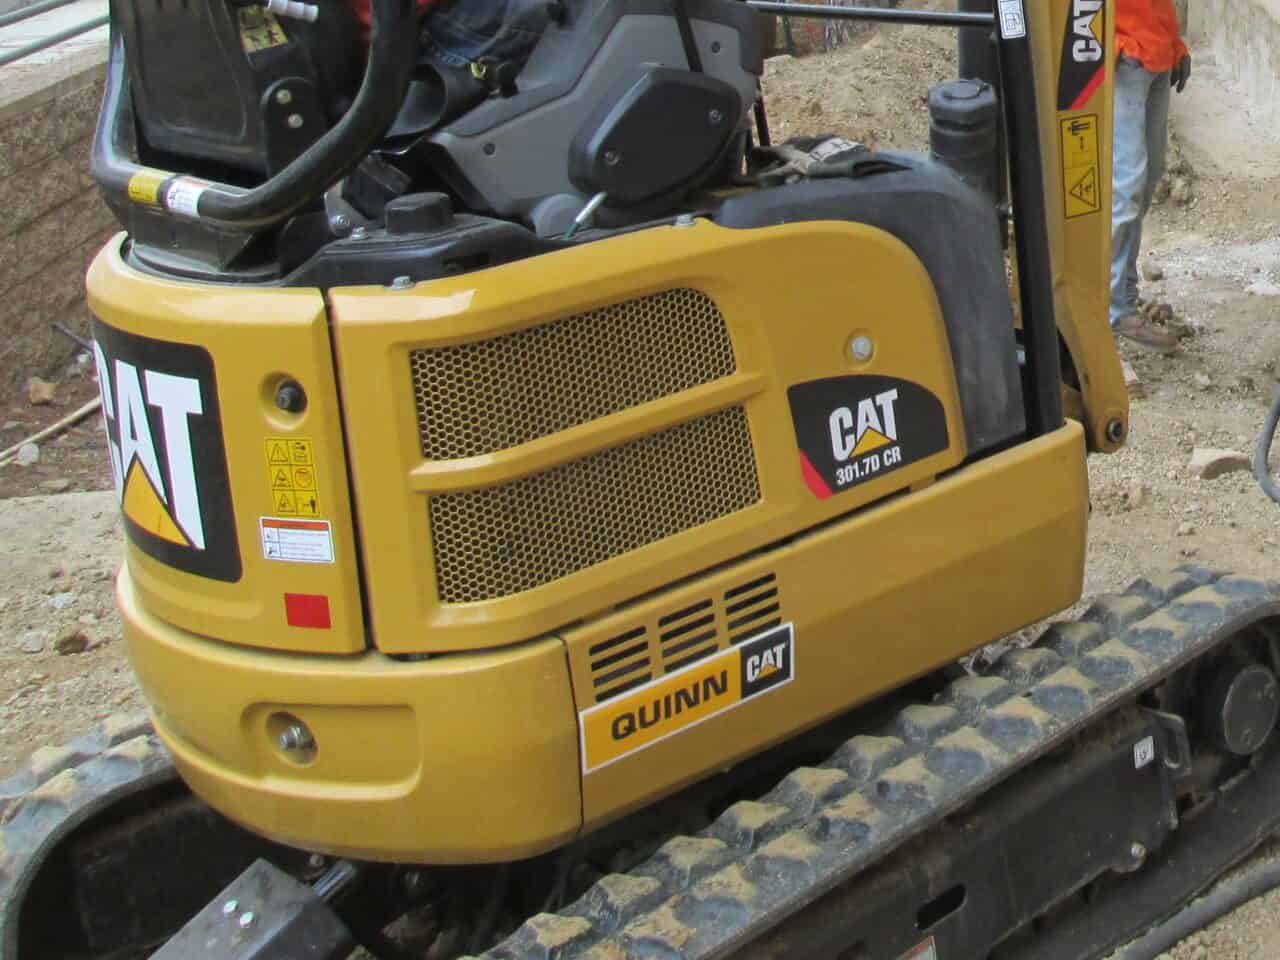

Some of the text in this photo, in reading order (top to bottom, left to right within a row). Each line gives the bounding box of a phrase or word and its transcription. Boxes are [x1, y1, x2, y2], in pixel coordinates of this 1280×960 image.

[829, 389, 898, 461] CAT
[836, 446, 902, 485] 301.7D CR
[611, 643, 785, 740] QUINN CAT
